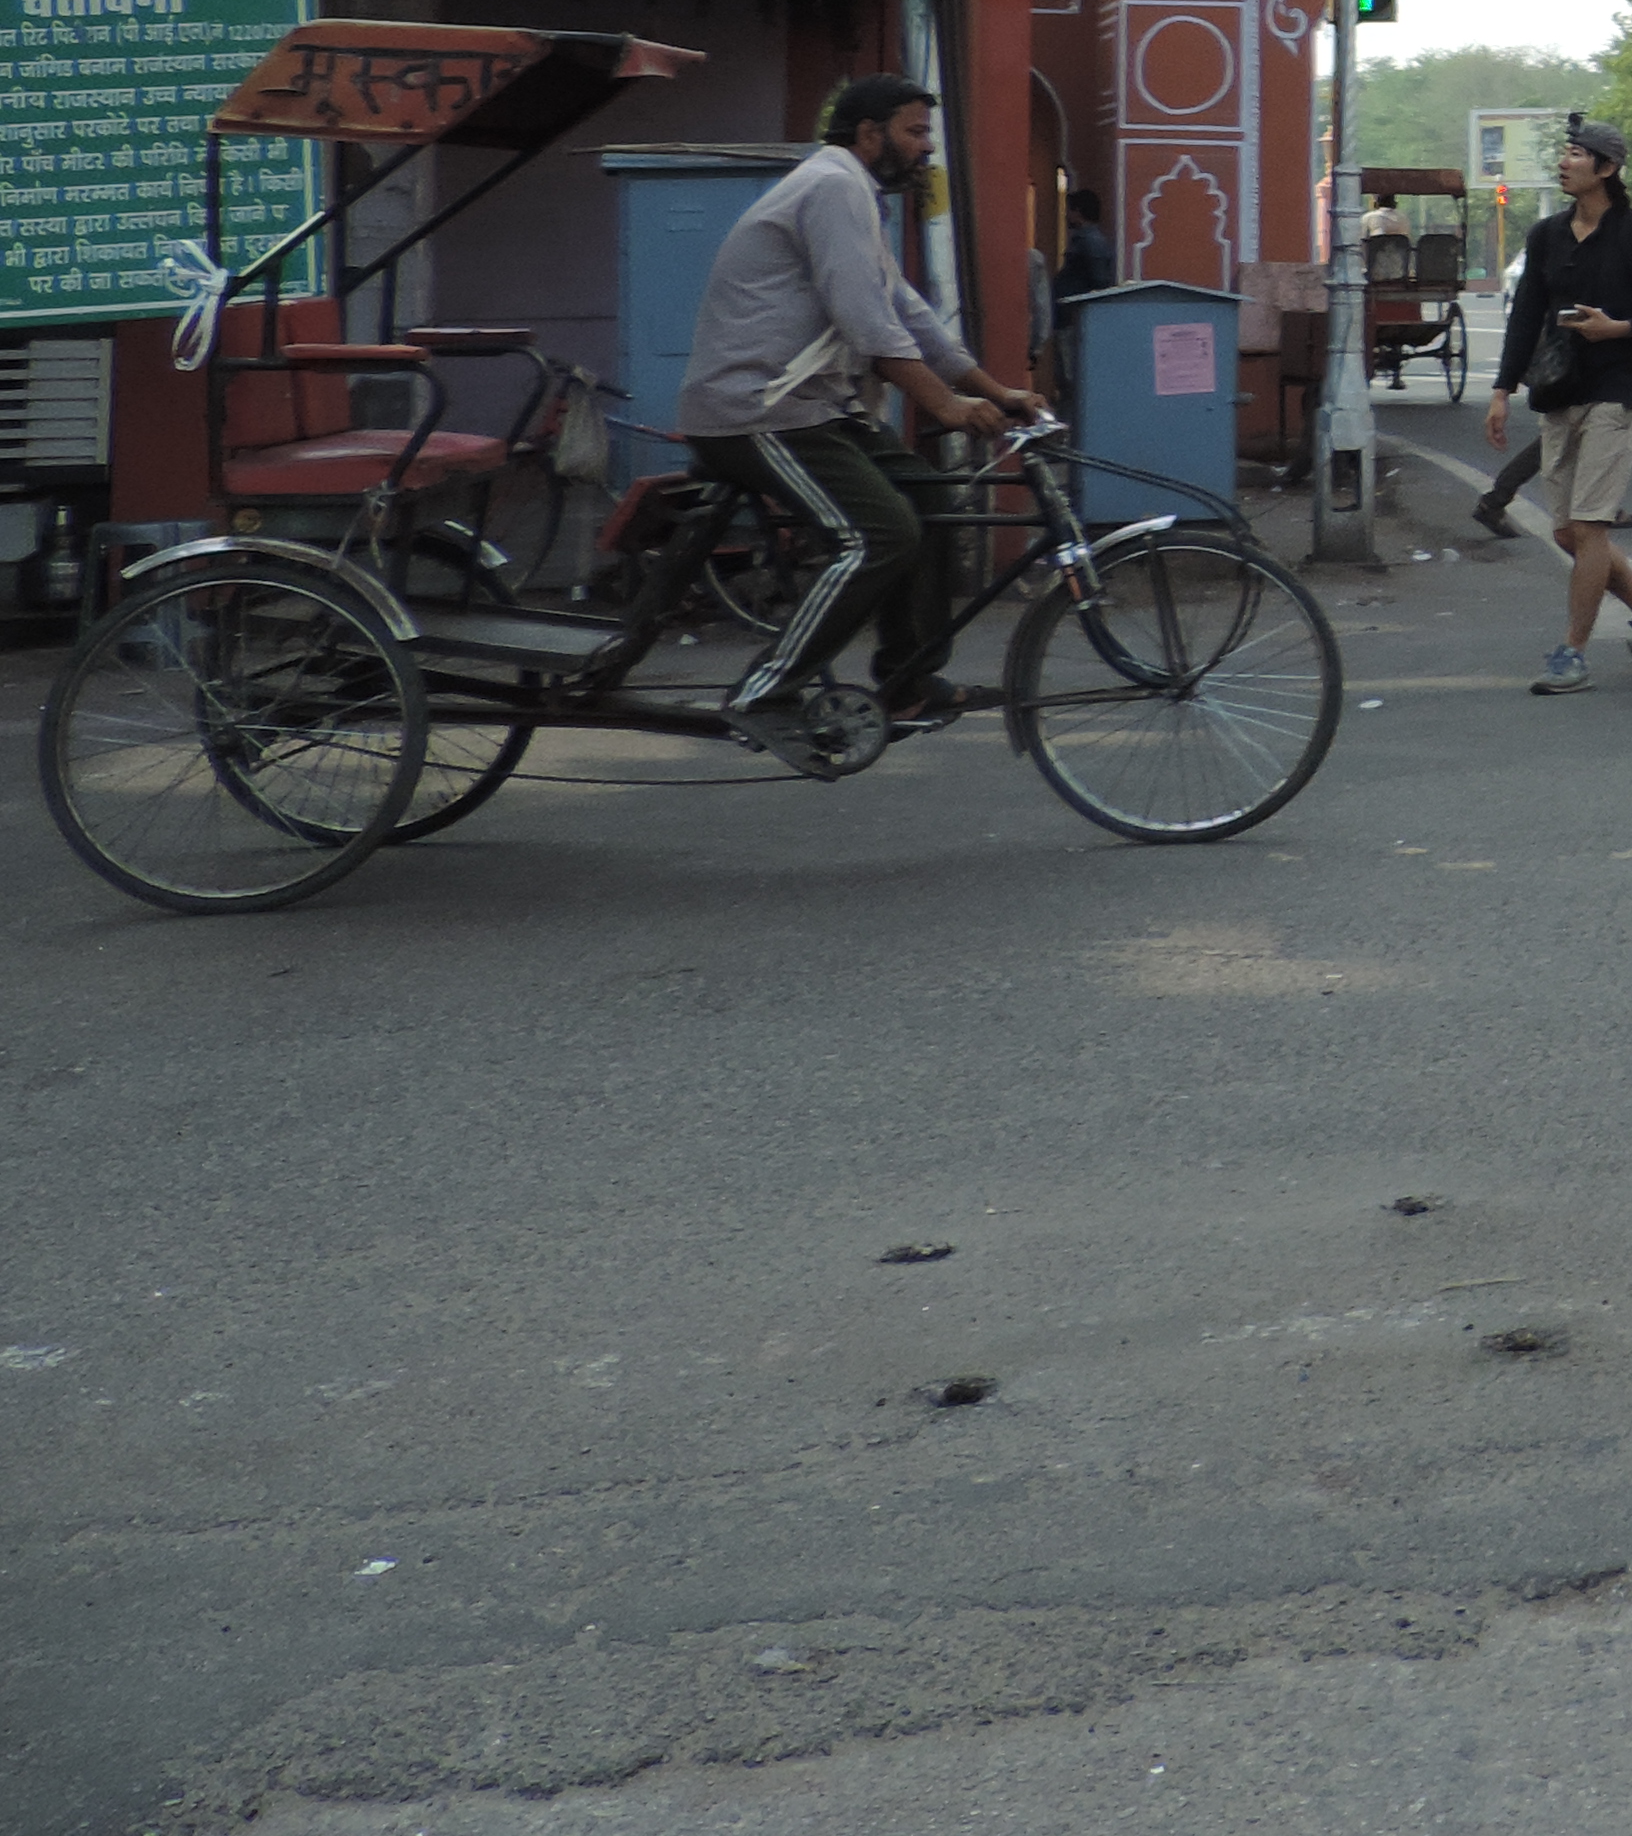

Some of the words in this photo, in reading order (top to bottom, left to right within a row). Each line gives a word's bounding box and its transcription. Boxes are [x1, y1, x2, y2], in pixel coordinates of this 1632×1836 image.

[50, 87, 137, 110] राजस्थान
[134, 116, 163, 136] पर
[60, 146, 105, 172] मीटर
[4, 242, 27, 266] भी
[27, 276, 54, 294] पर
[57, 268, 83, 291] की
[87, 272, 112, 290] जा
